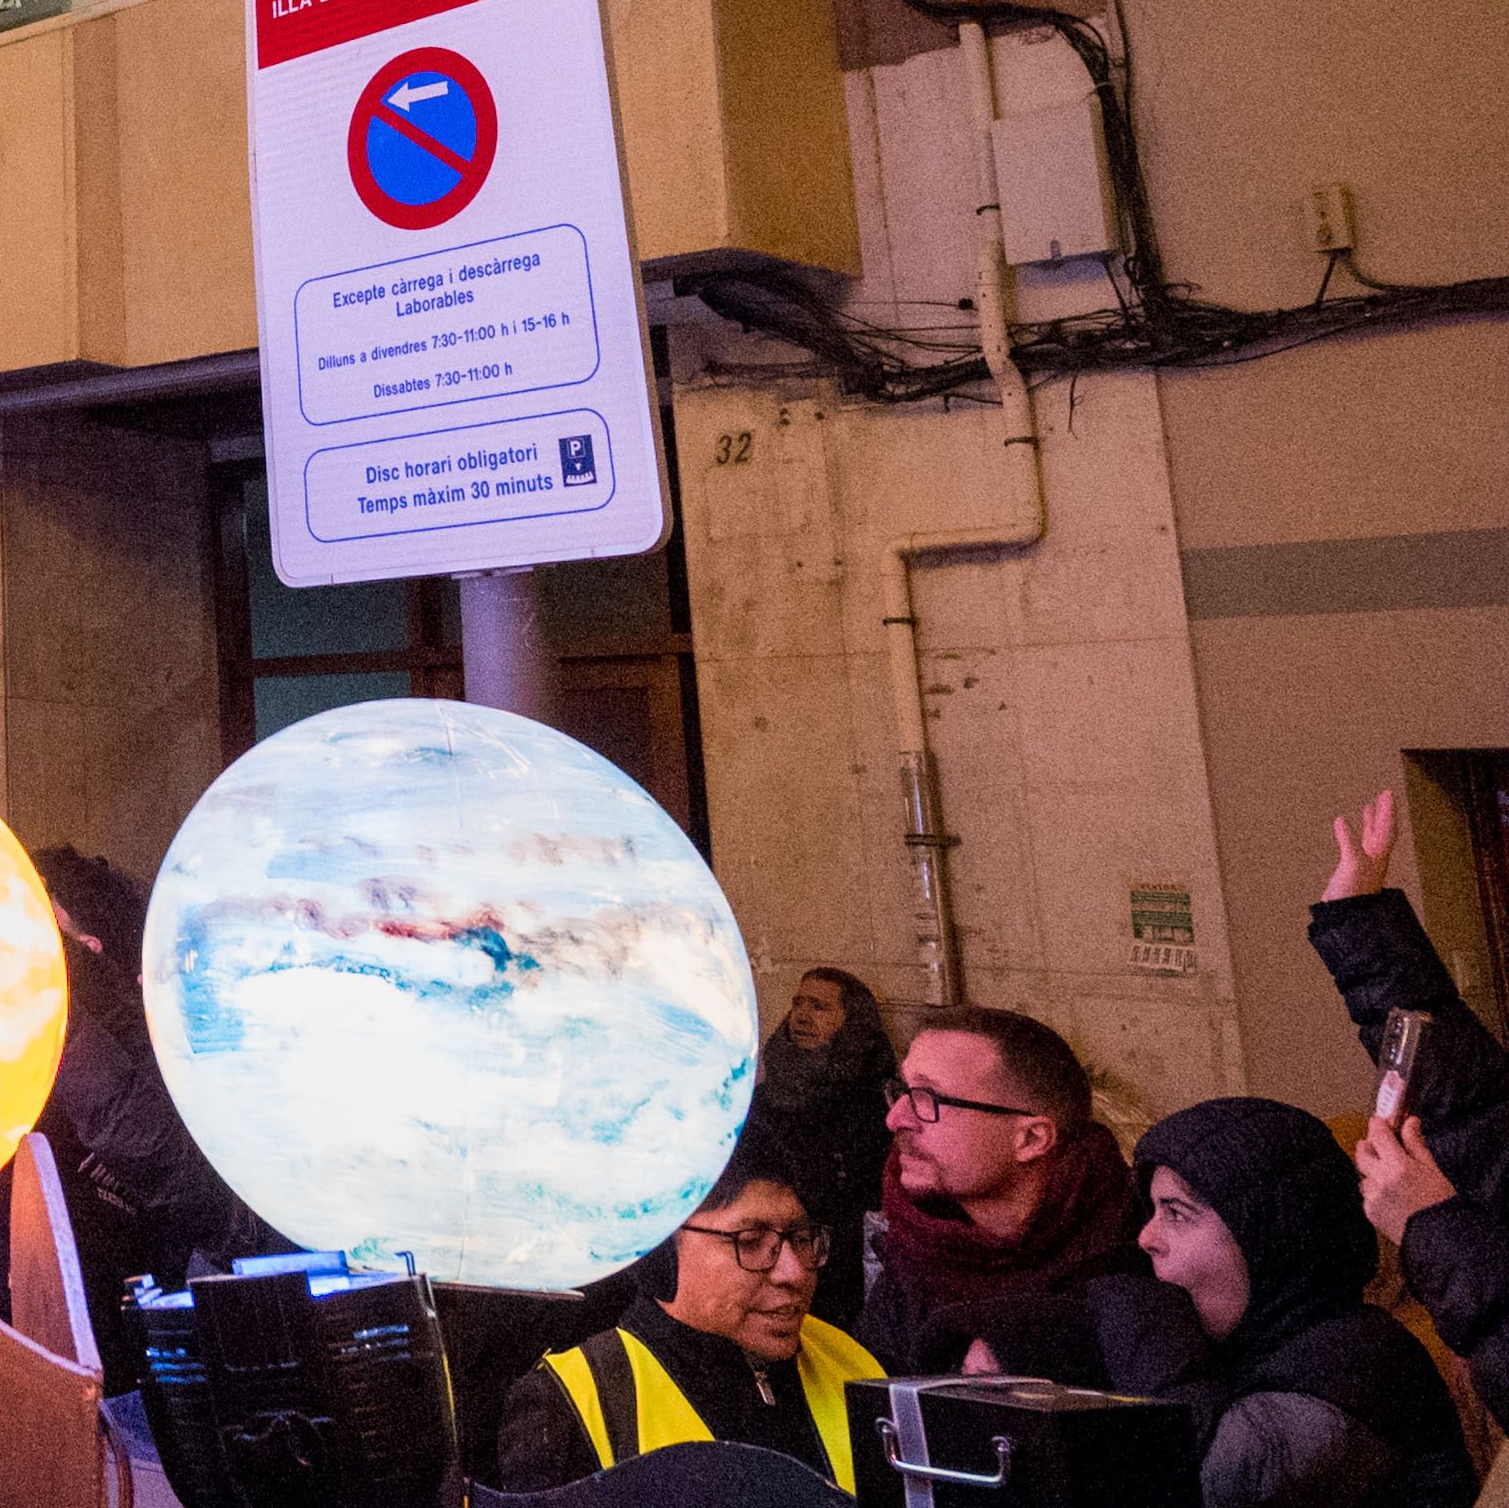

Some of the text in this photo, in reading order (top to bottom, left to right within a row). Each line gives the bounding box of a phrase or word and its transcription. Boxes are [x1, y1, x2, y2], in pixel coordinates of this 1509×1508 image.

[332, 253, 541, 308] Excepte càrrega i descàrrega
[396, 289, 474, 317] Laborables
[318, 311, 570, 371] Dilluns a divendres 7:30-11:00 h i 15-16 h
[373, 361, 513, 398] Dissabtes 7:30-11:00 h
[365, 443, 538, 484] Disc horari obligatori
[569, 440, 582, 458] P
[716, 432, 751, 465] 32
[357, 473, 553, 514] Temps màxim 30 minuts
